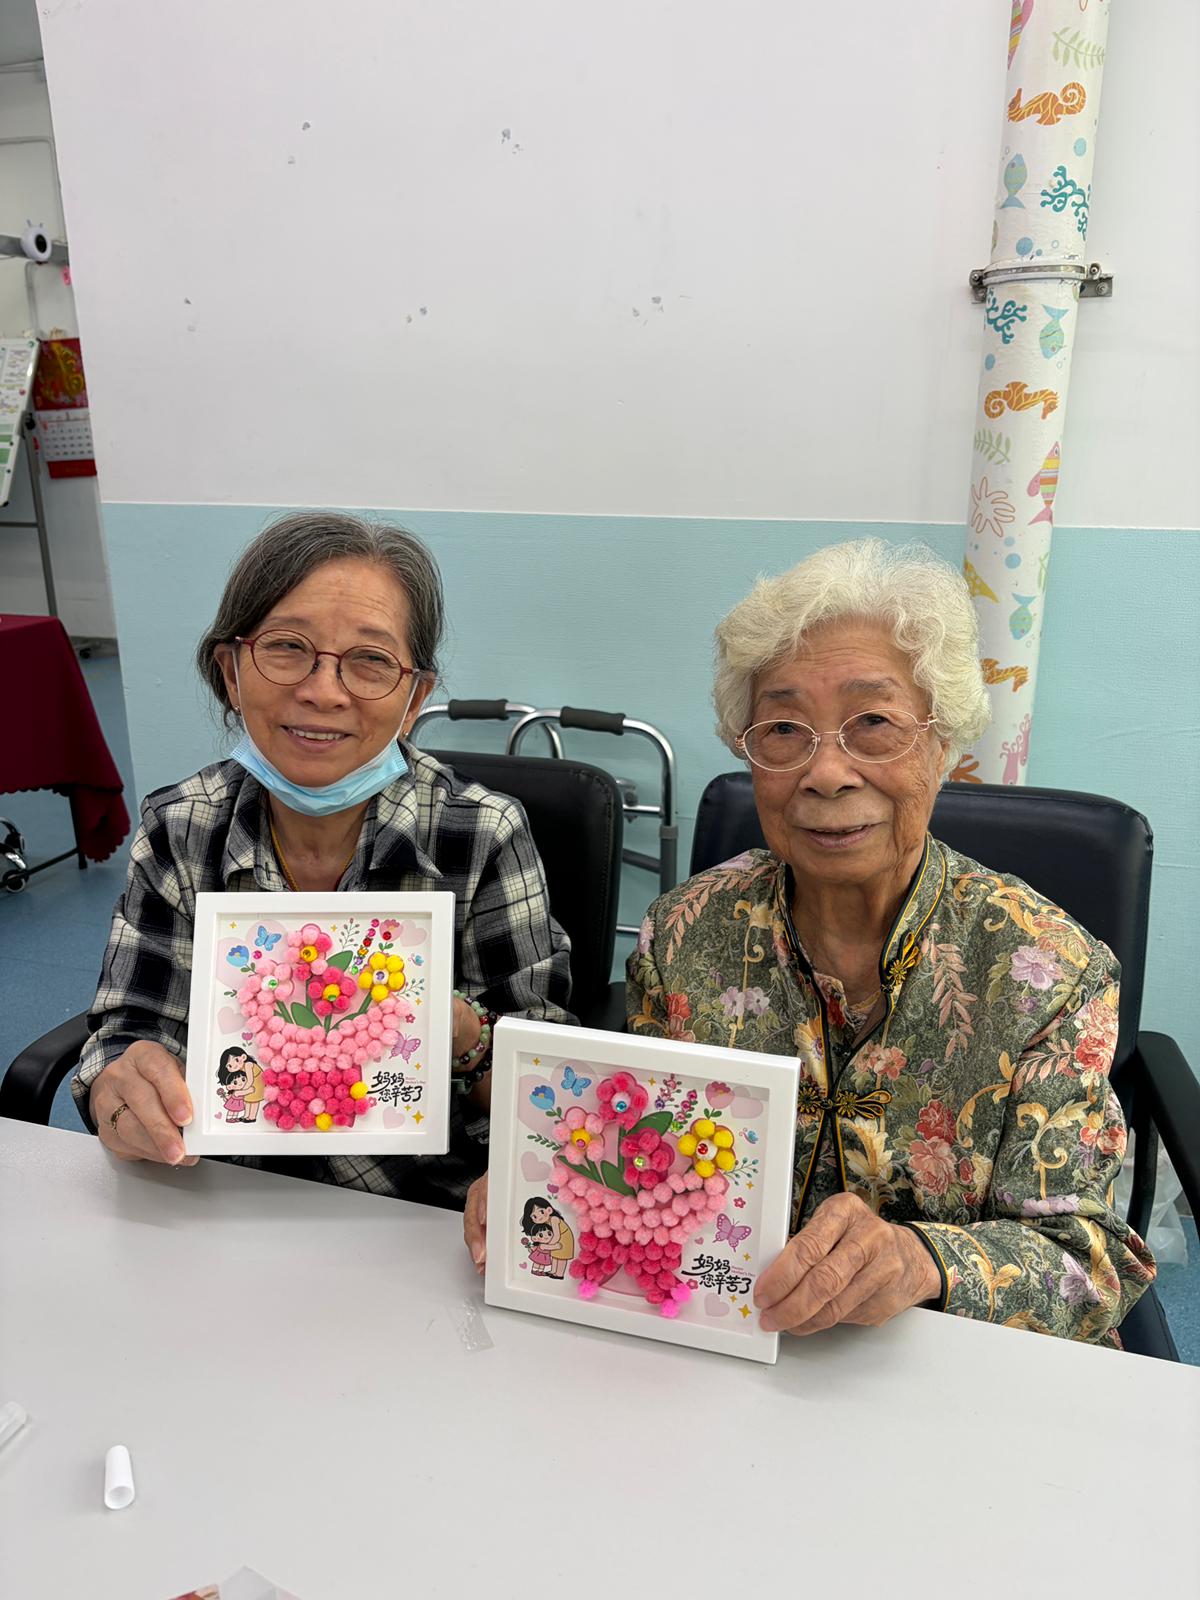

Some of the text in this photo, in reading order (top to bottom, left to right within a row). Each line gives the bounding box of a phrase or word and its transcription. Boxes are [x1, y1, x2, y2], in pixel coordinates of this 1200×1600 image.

[366, 1071, 404, 1094] 妈妈
[378, 1085, 422, 1107] 您辛苦了
[681, 1254, 731, 1276] 妈妈
[699, 1272, 752, 1295] 您辛苦了
